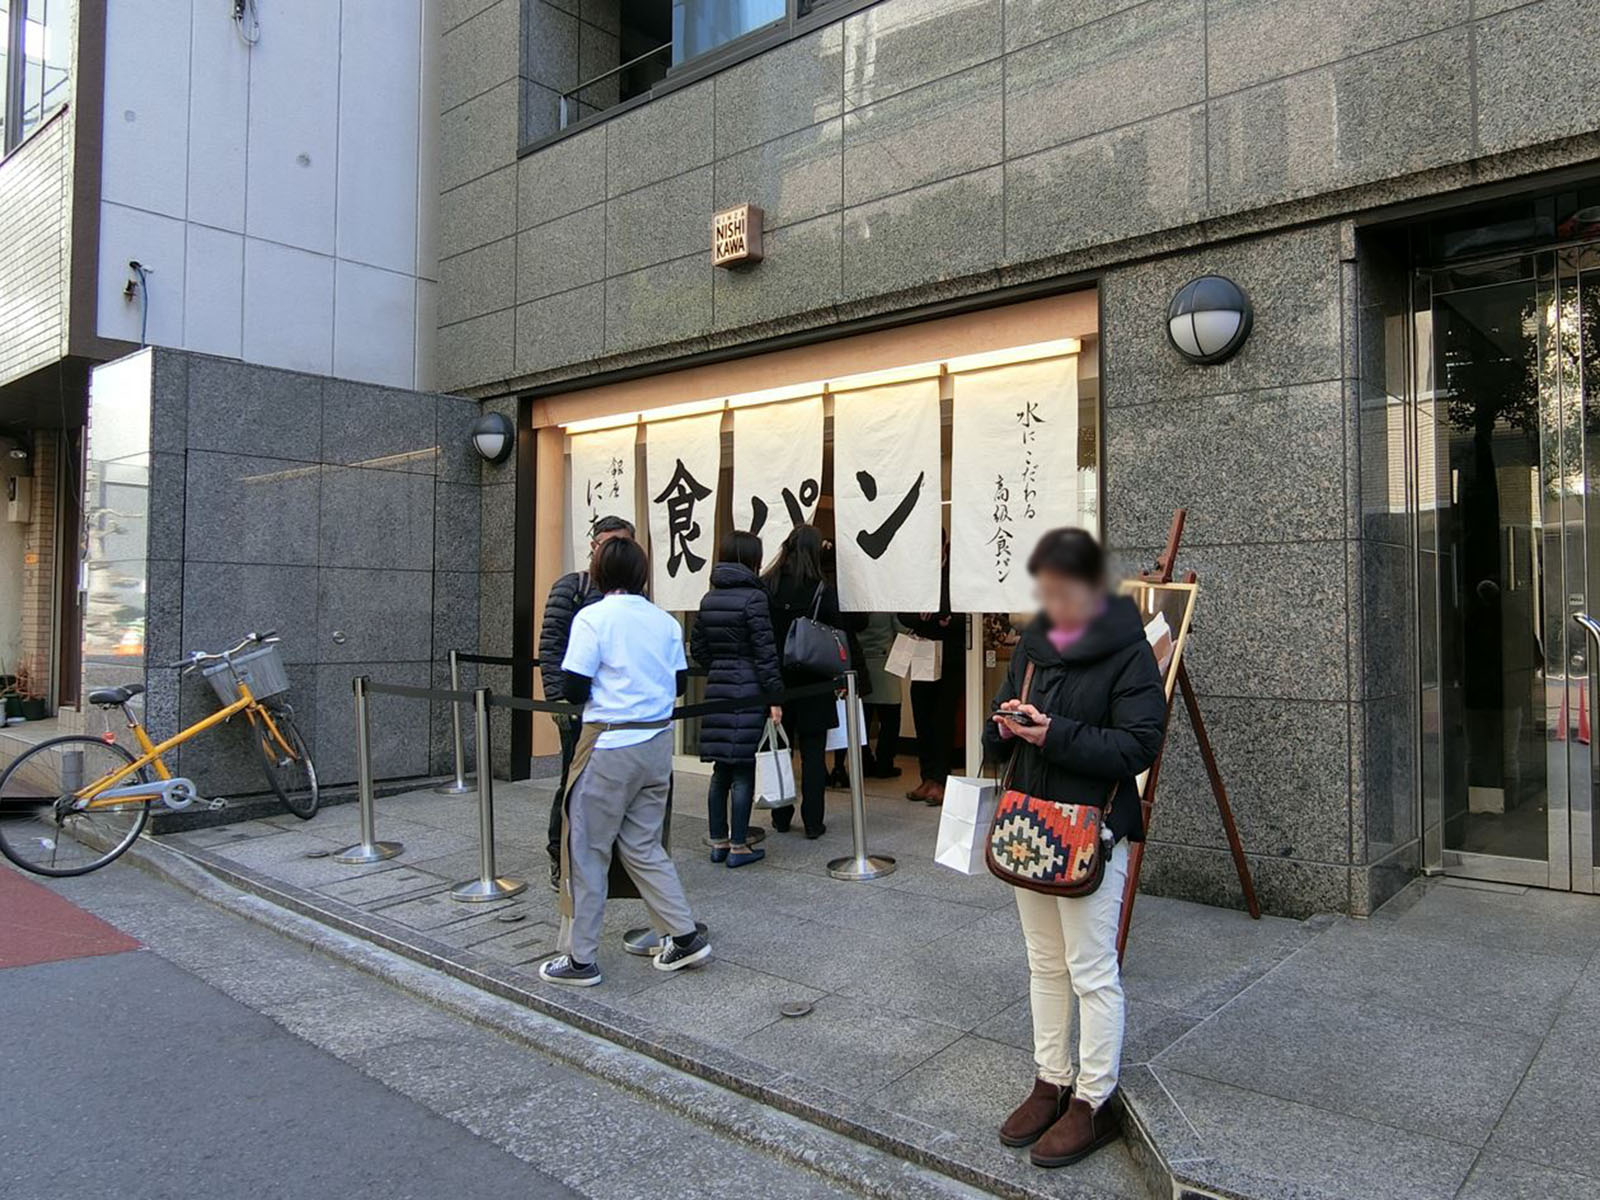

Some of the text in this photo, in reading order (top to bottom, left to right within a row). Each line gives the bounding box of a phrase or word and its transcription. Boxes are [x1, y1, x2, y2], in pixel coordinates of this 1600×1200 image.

[716, 218, 745, 242] NISHI
[716, 236, 745, 259] KAWA
[1016, 400, 1046, 519] 水にこだわる
[985, 473, 1013, 583] 高級食パン
